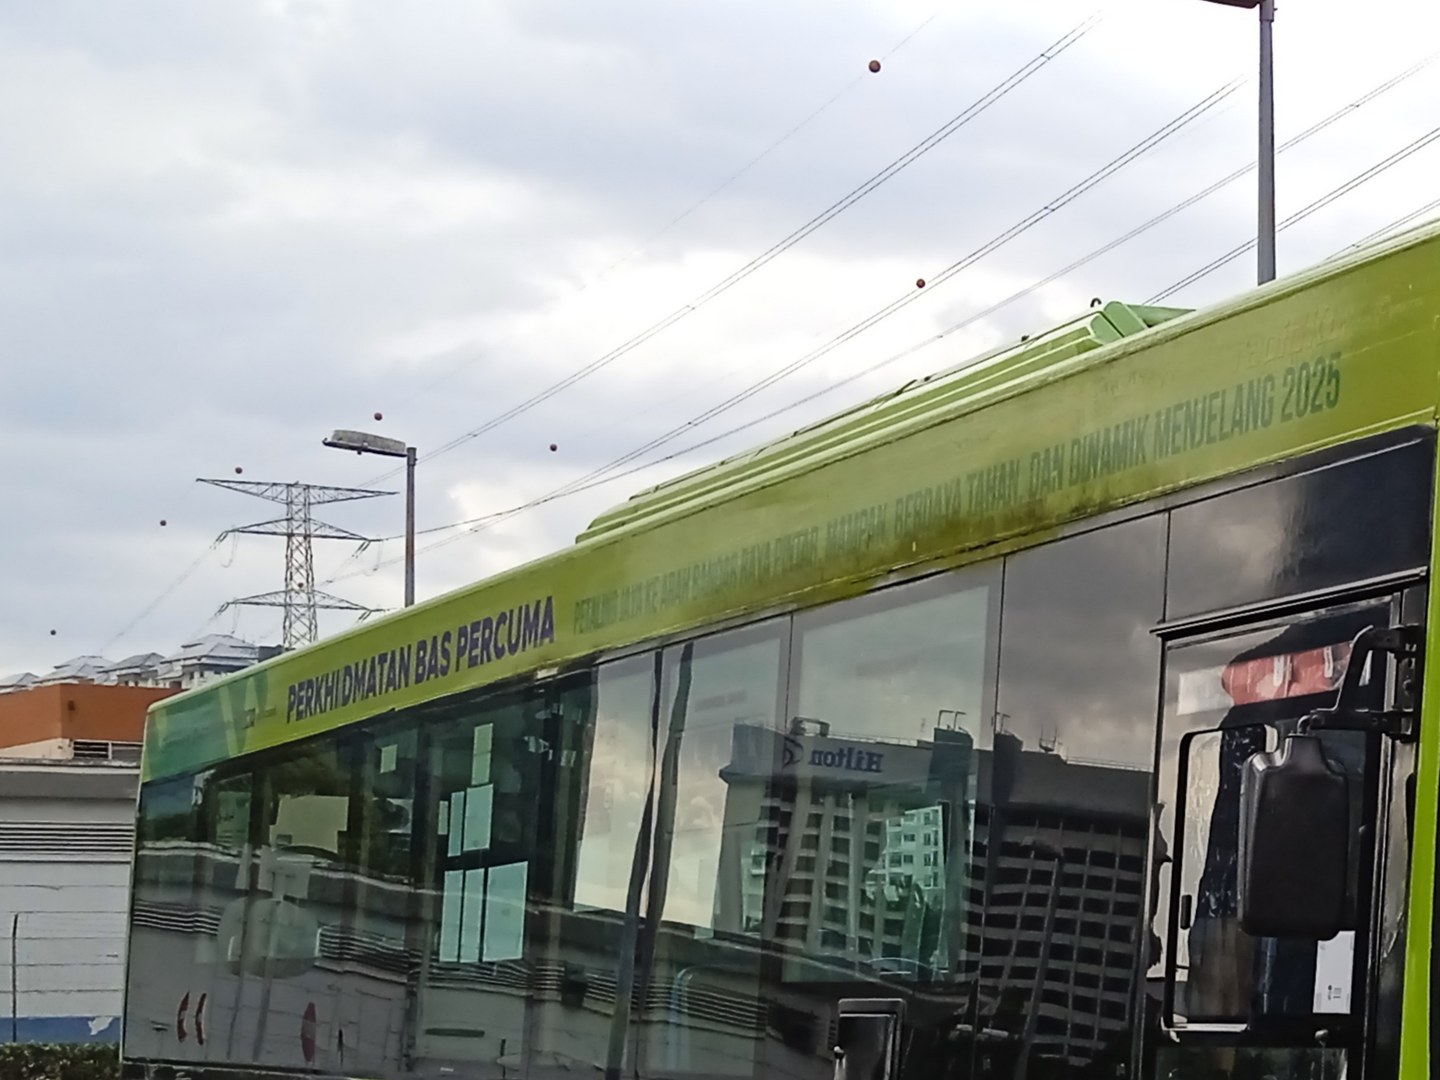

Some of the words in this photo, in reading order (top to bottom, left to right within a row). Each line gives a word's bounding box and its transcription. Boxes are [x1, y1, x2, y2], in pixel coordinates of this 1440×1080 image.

[1028, 442, 1065, 500] DAN
[1069, 414, 1150, 486] DINAMIK
[1153, 374, 1275, 460] MENJELANG
[1281, 351, 1342, 423] 2025
[286, 644, 412, 724] PERKHIDMATAN
[414, 631, 451, 683] BAS
[455, 596, 555, 672] PERCUMA
